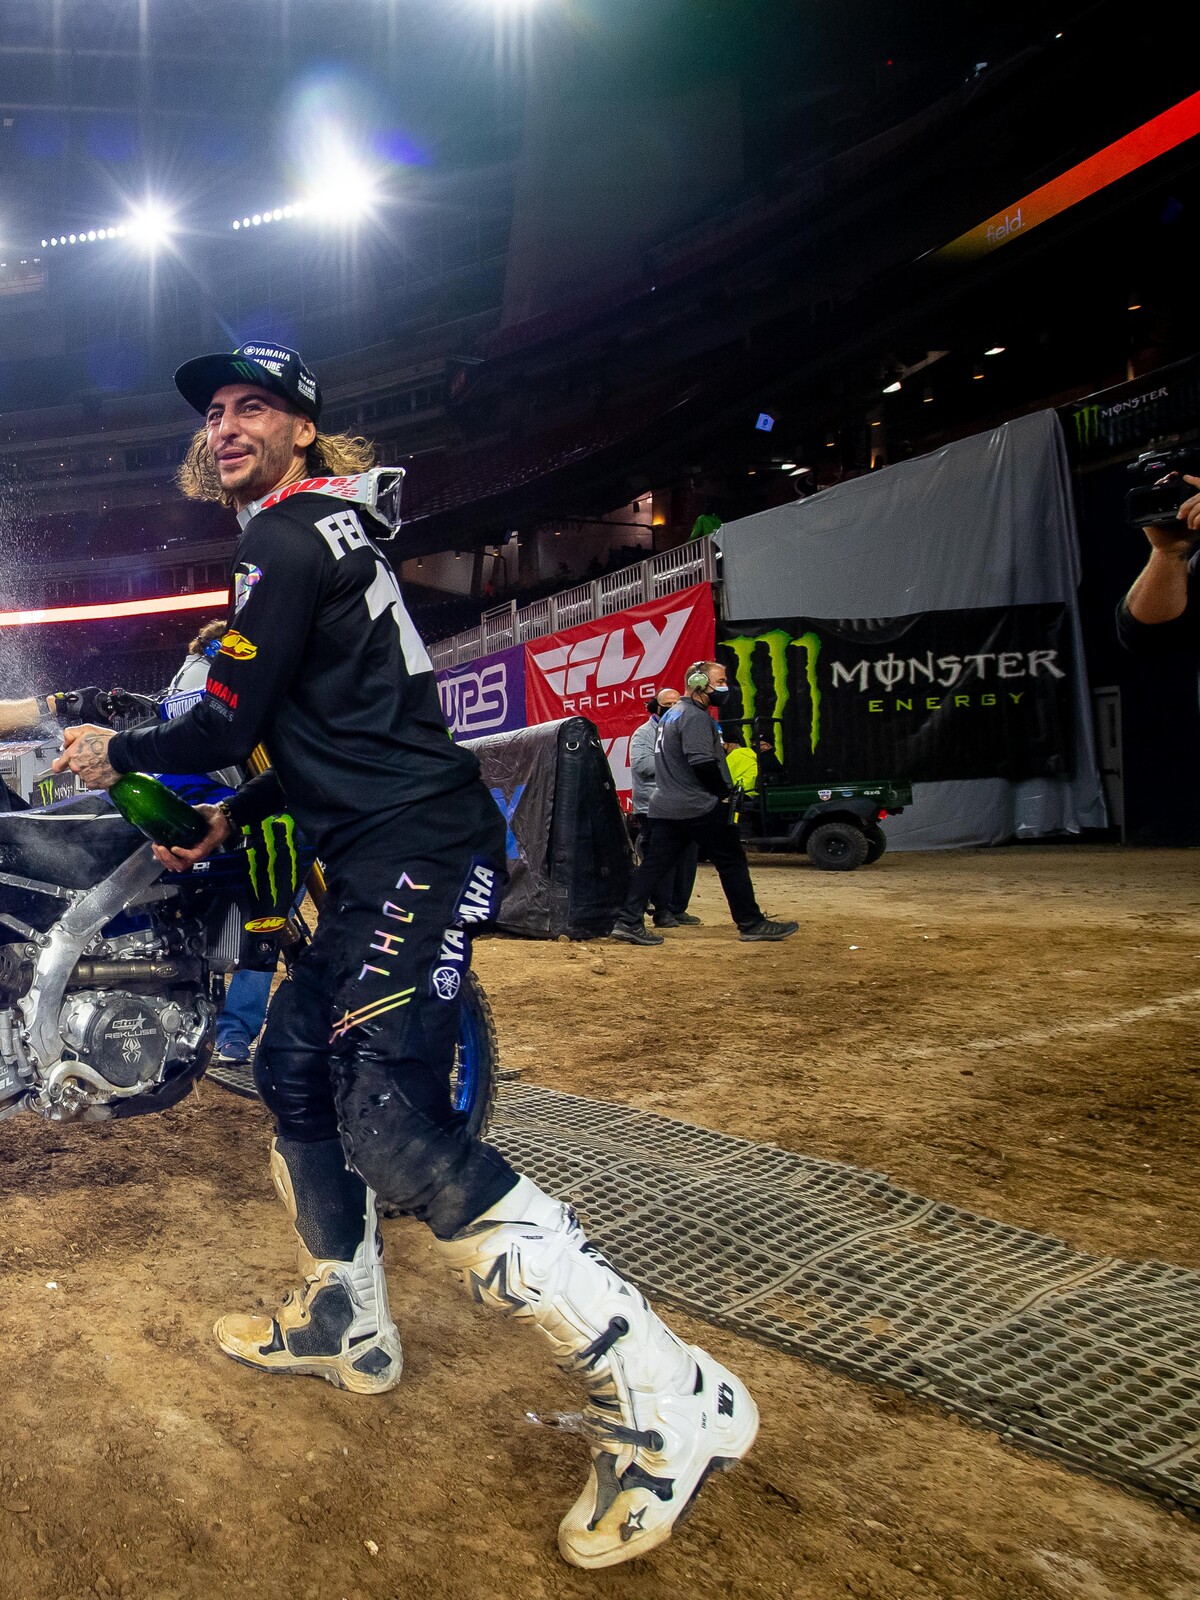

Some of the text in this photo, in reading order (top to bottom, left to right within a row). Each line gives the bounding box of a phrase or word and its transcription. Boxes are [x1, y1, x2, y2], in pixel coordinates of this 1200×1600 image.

[255, 348, 290, 362] YAMAHA
[1102, 387, 1169, 419] MONSTER
[533, 606, 694, 696] FLY
[831, 651, 1066, 692] MONSTER
[563, 683, 655, 713] RACING
[868, 692, 1025, 713] ENERGY
[440, 865, 494, 962] YAAHA
[105, 1028, 157, 1039] REKLUSE
